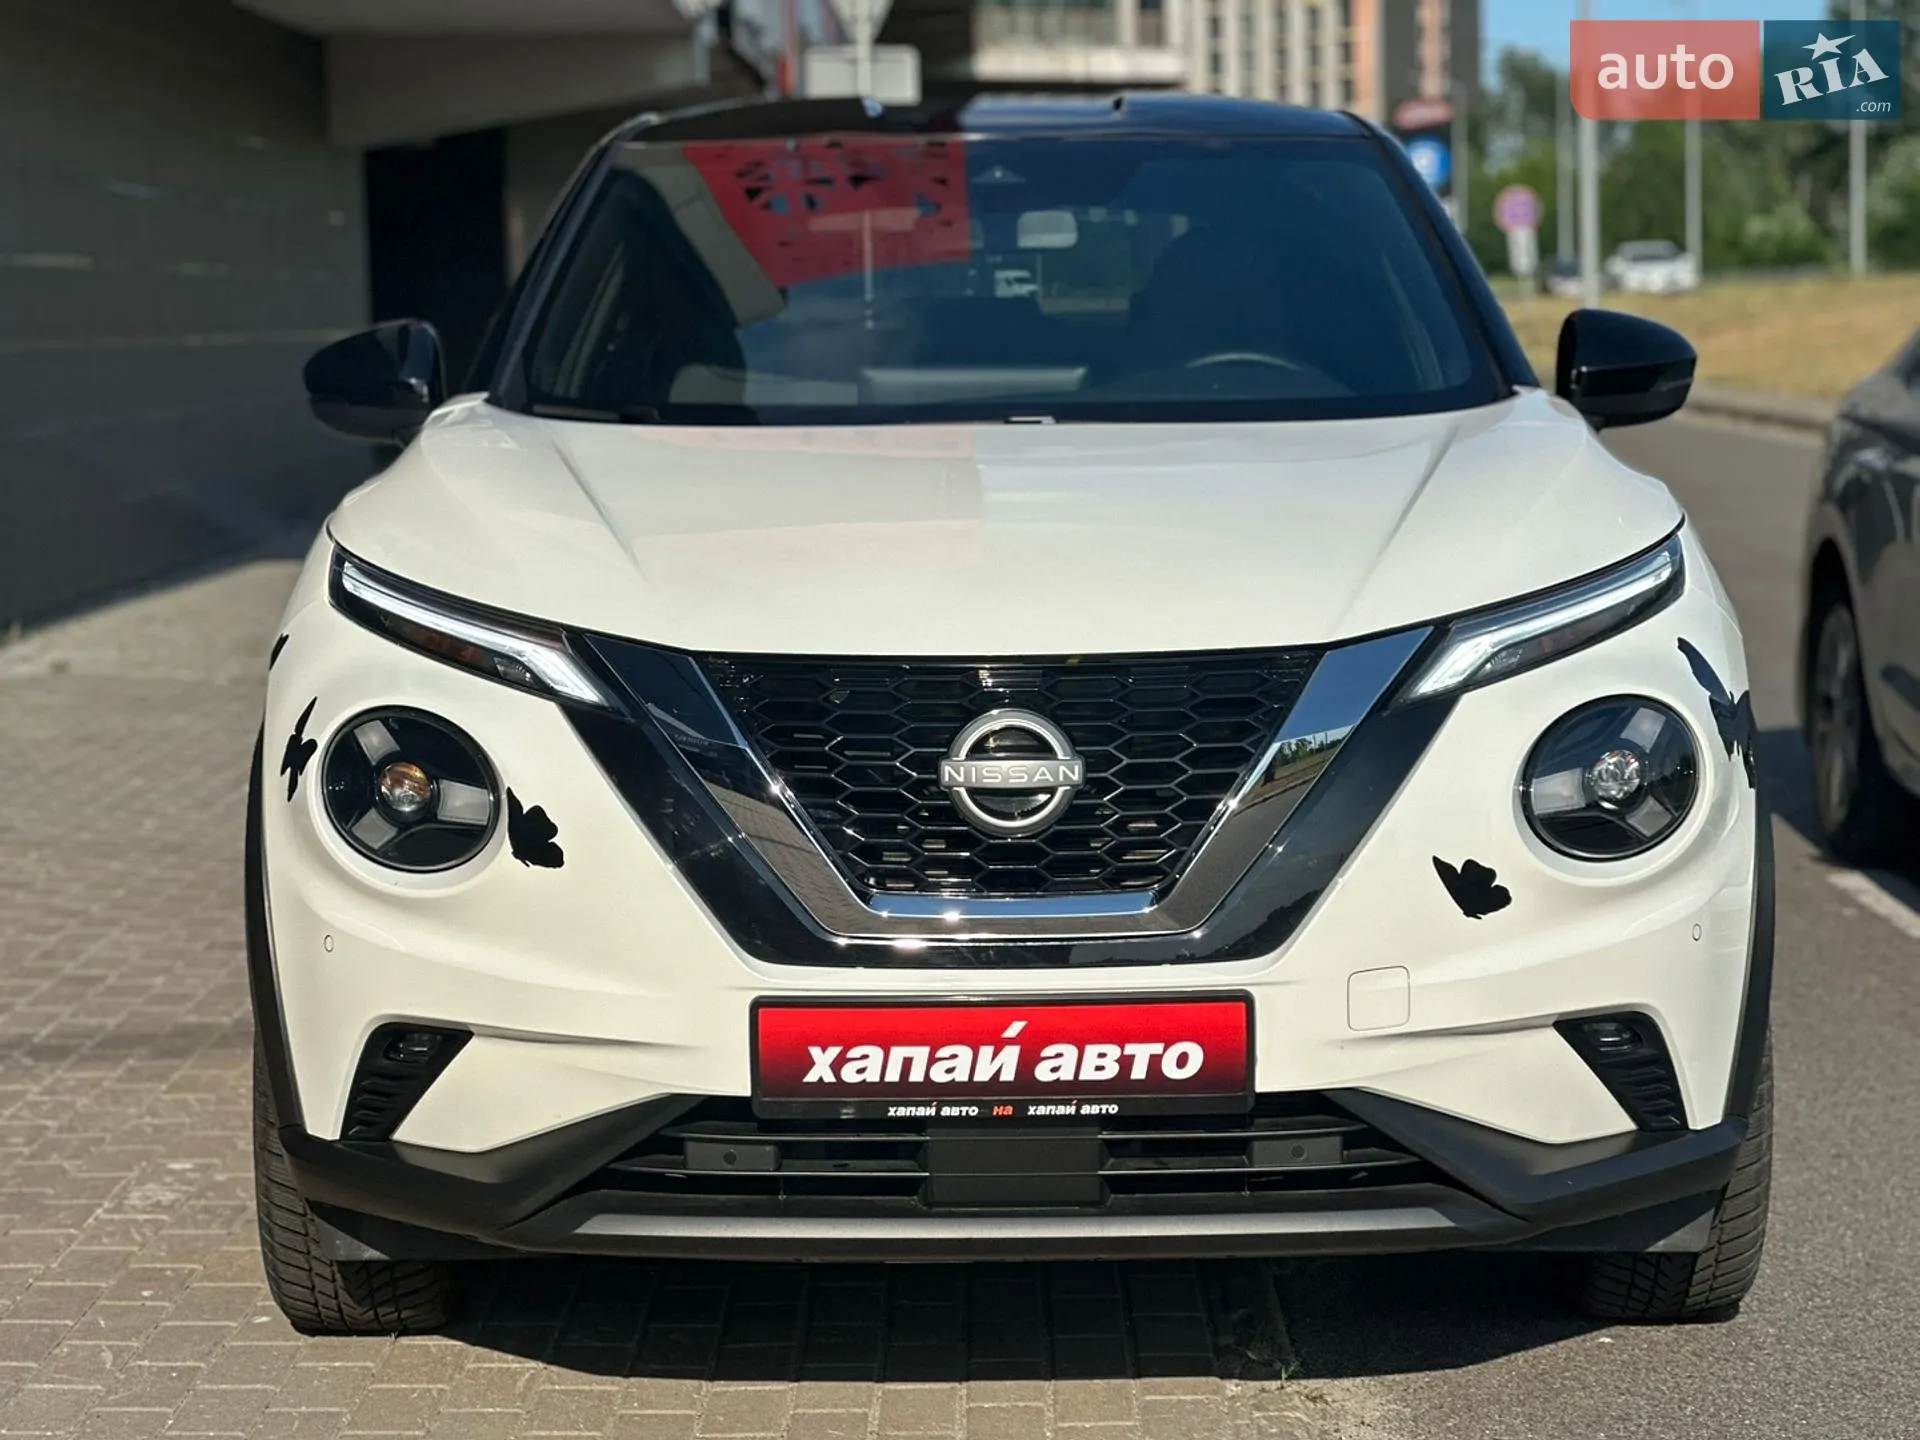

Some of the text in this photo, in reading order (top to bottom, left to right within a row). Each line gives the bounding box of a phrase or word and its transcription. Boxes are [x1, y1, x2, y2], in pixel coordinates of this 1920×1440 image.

[944, 764, 1079, 783] NISSAN
[1034, 1040, 1204, 1083] авто
[940, 1104, 979, 1116] авто
[992, 1104, 1014, 1116] на
[1080, 1102, 1119, 1115] авто
